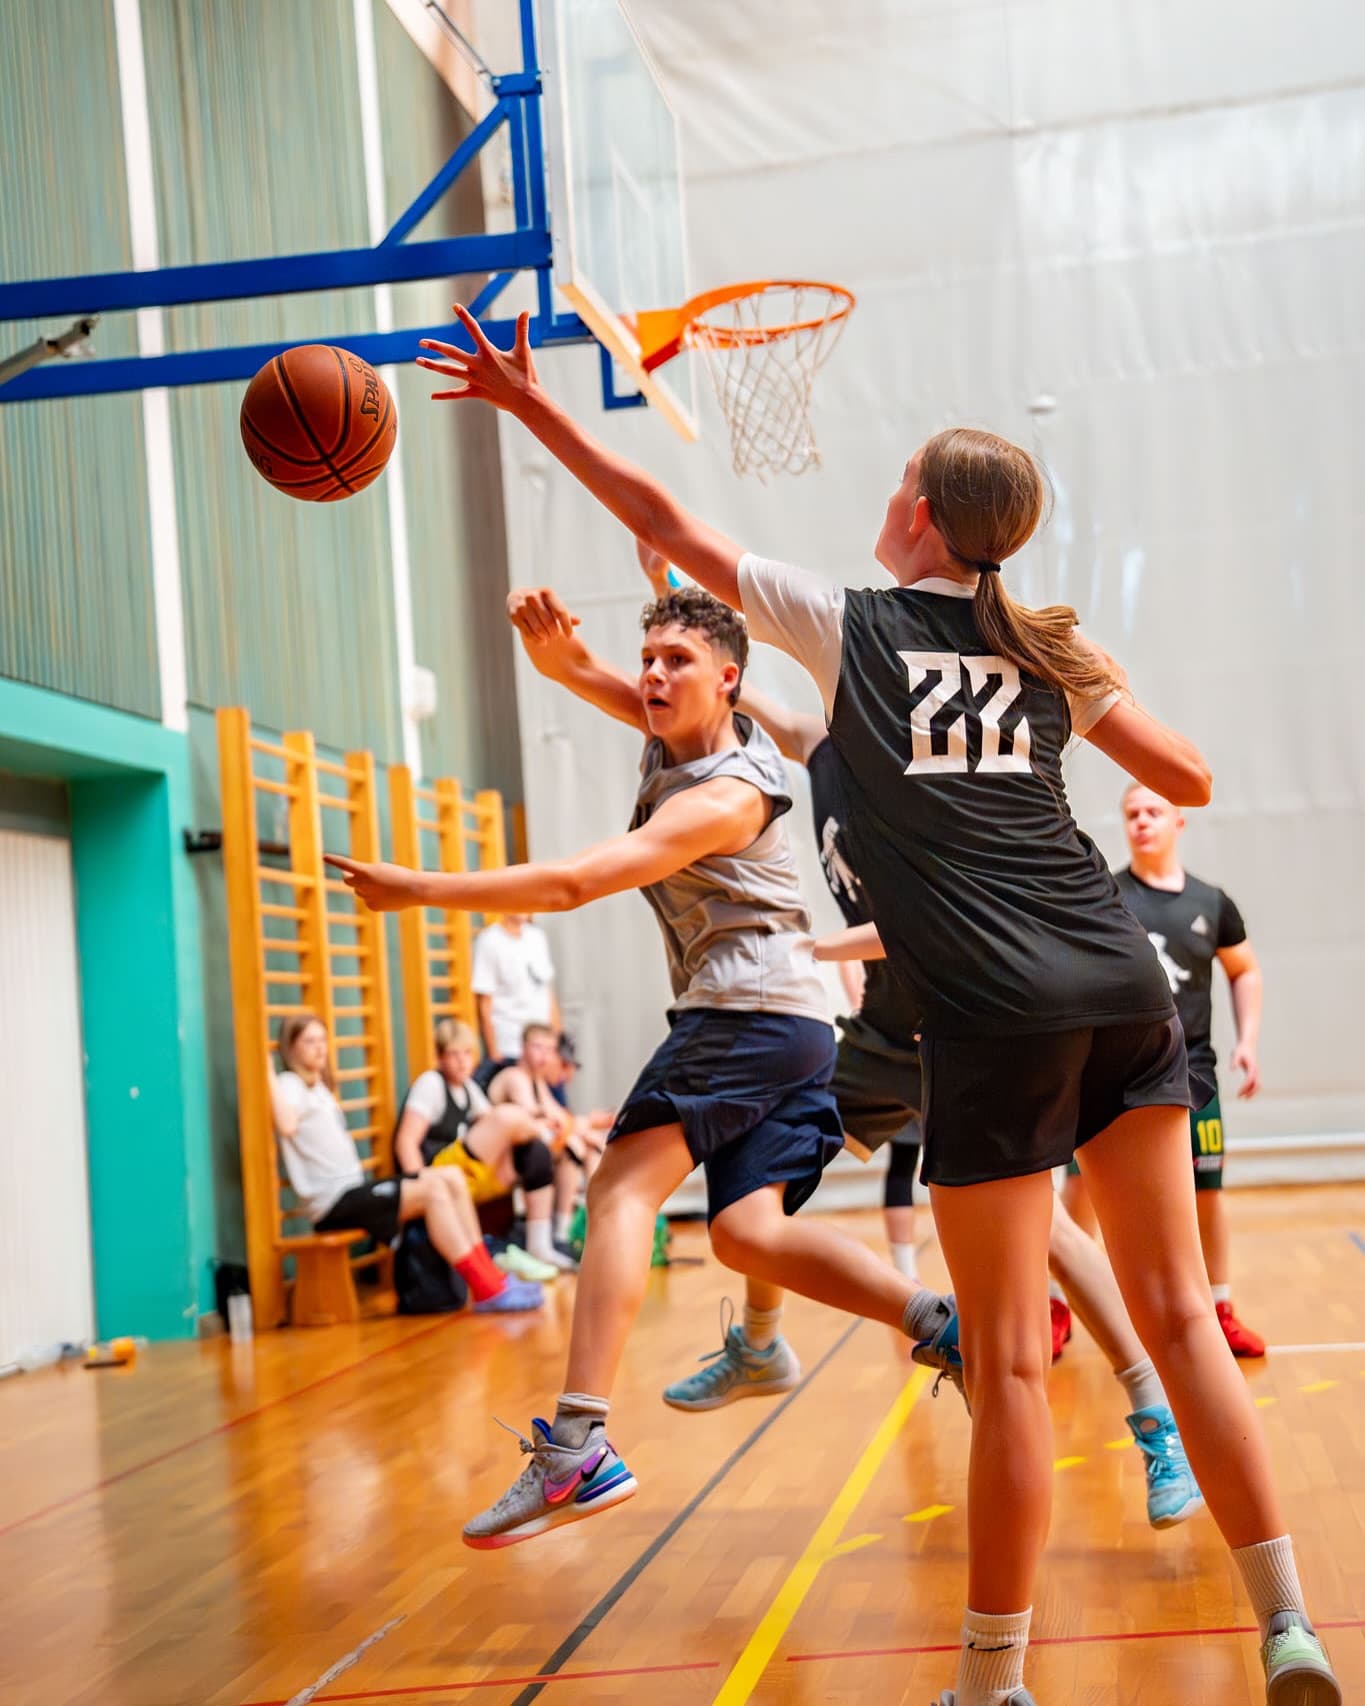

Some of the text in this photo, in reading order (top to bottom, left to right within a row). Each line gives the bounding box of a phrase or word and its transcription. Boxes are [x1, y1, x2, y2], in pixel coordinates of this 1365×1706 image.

[360, 361, 379, 423] SPAL
[896, 650, 1032, 775] 22
[1197, 1119, 1222, 1153] 10
